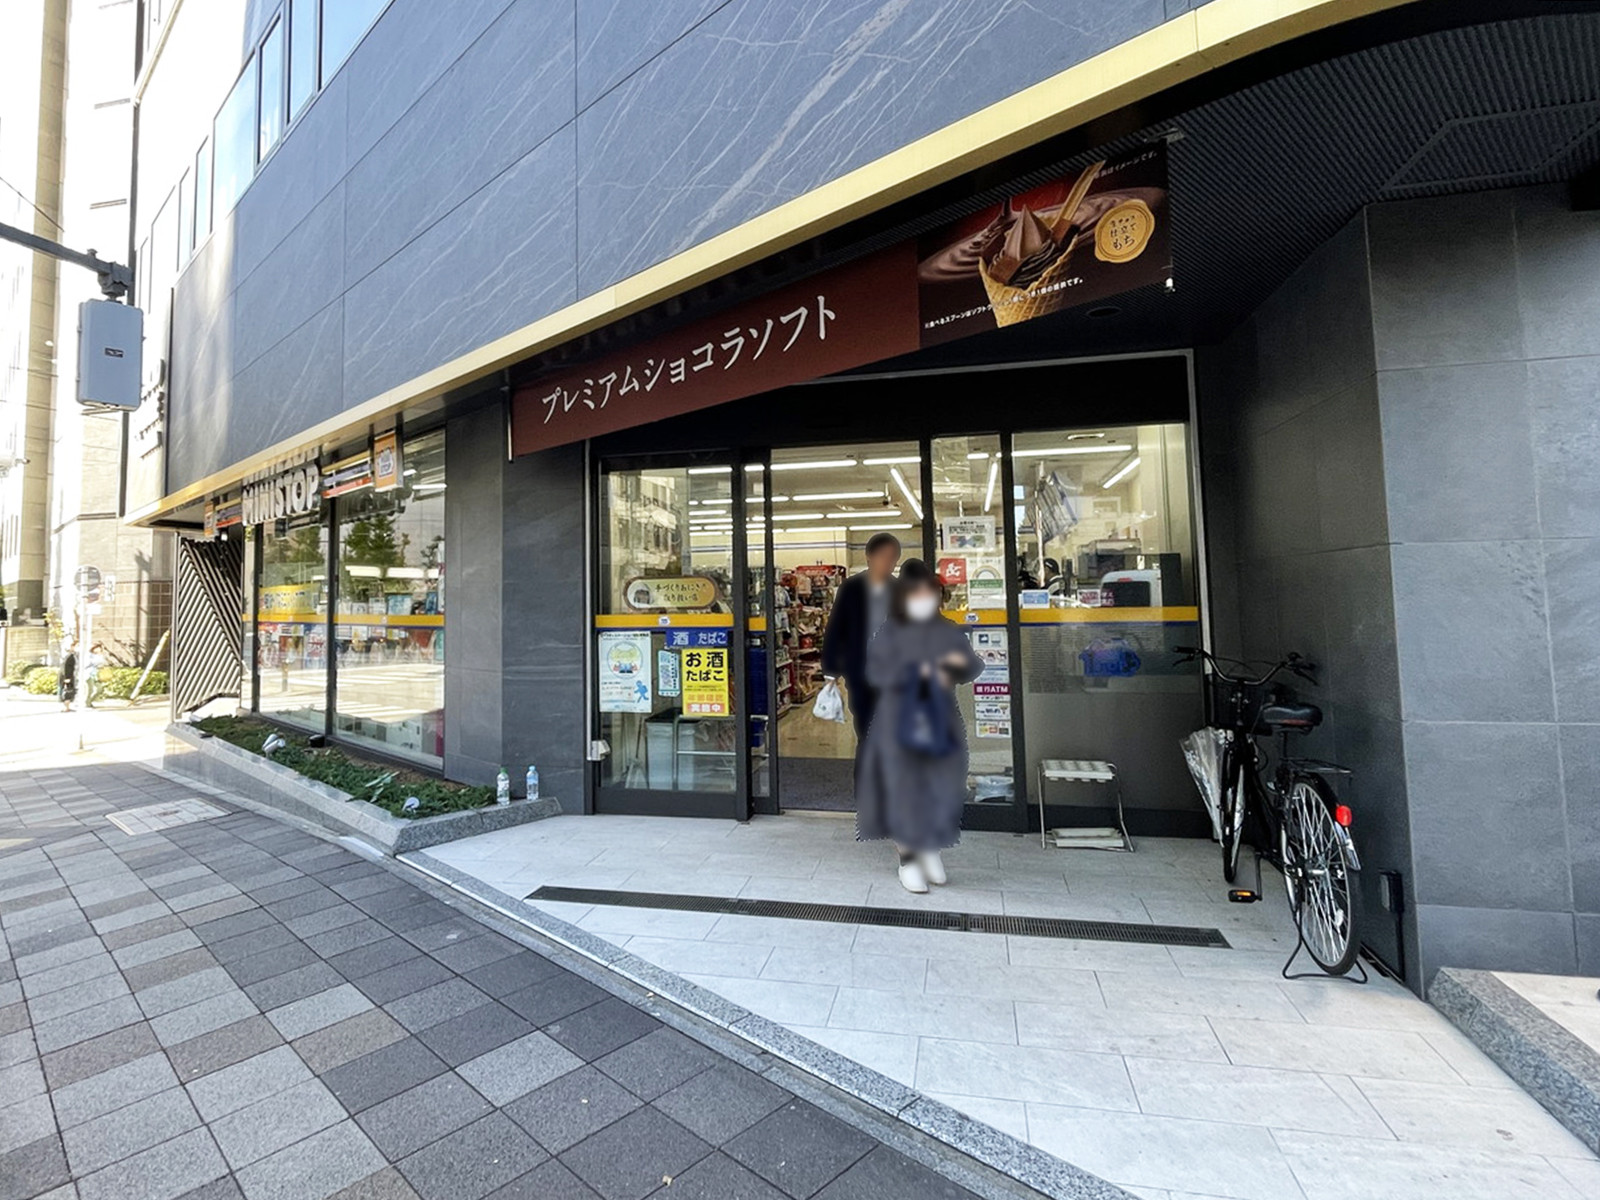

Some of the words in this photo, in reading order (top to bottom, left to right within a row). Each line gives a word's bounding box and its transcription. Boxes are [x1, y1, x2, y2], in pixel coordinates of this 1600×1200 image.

[1113, 235, 1135, 251] もち
[542, 295, 836, 424] プレミアムショコラソフト
[242, 463, 319, 526] MINISTOP
[673, 631, 689, 645] 酒
[697, 631, 727, 645] たばこ
[686, 651, 724, 668] お酒
[686, 670, 724, 682] たばこ
